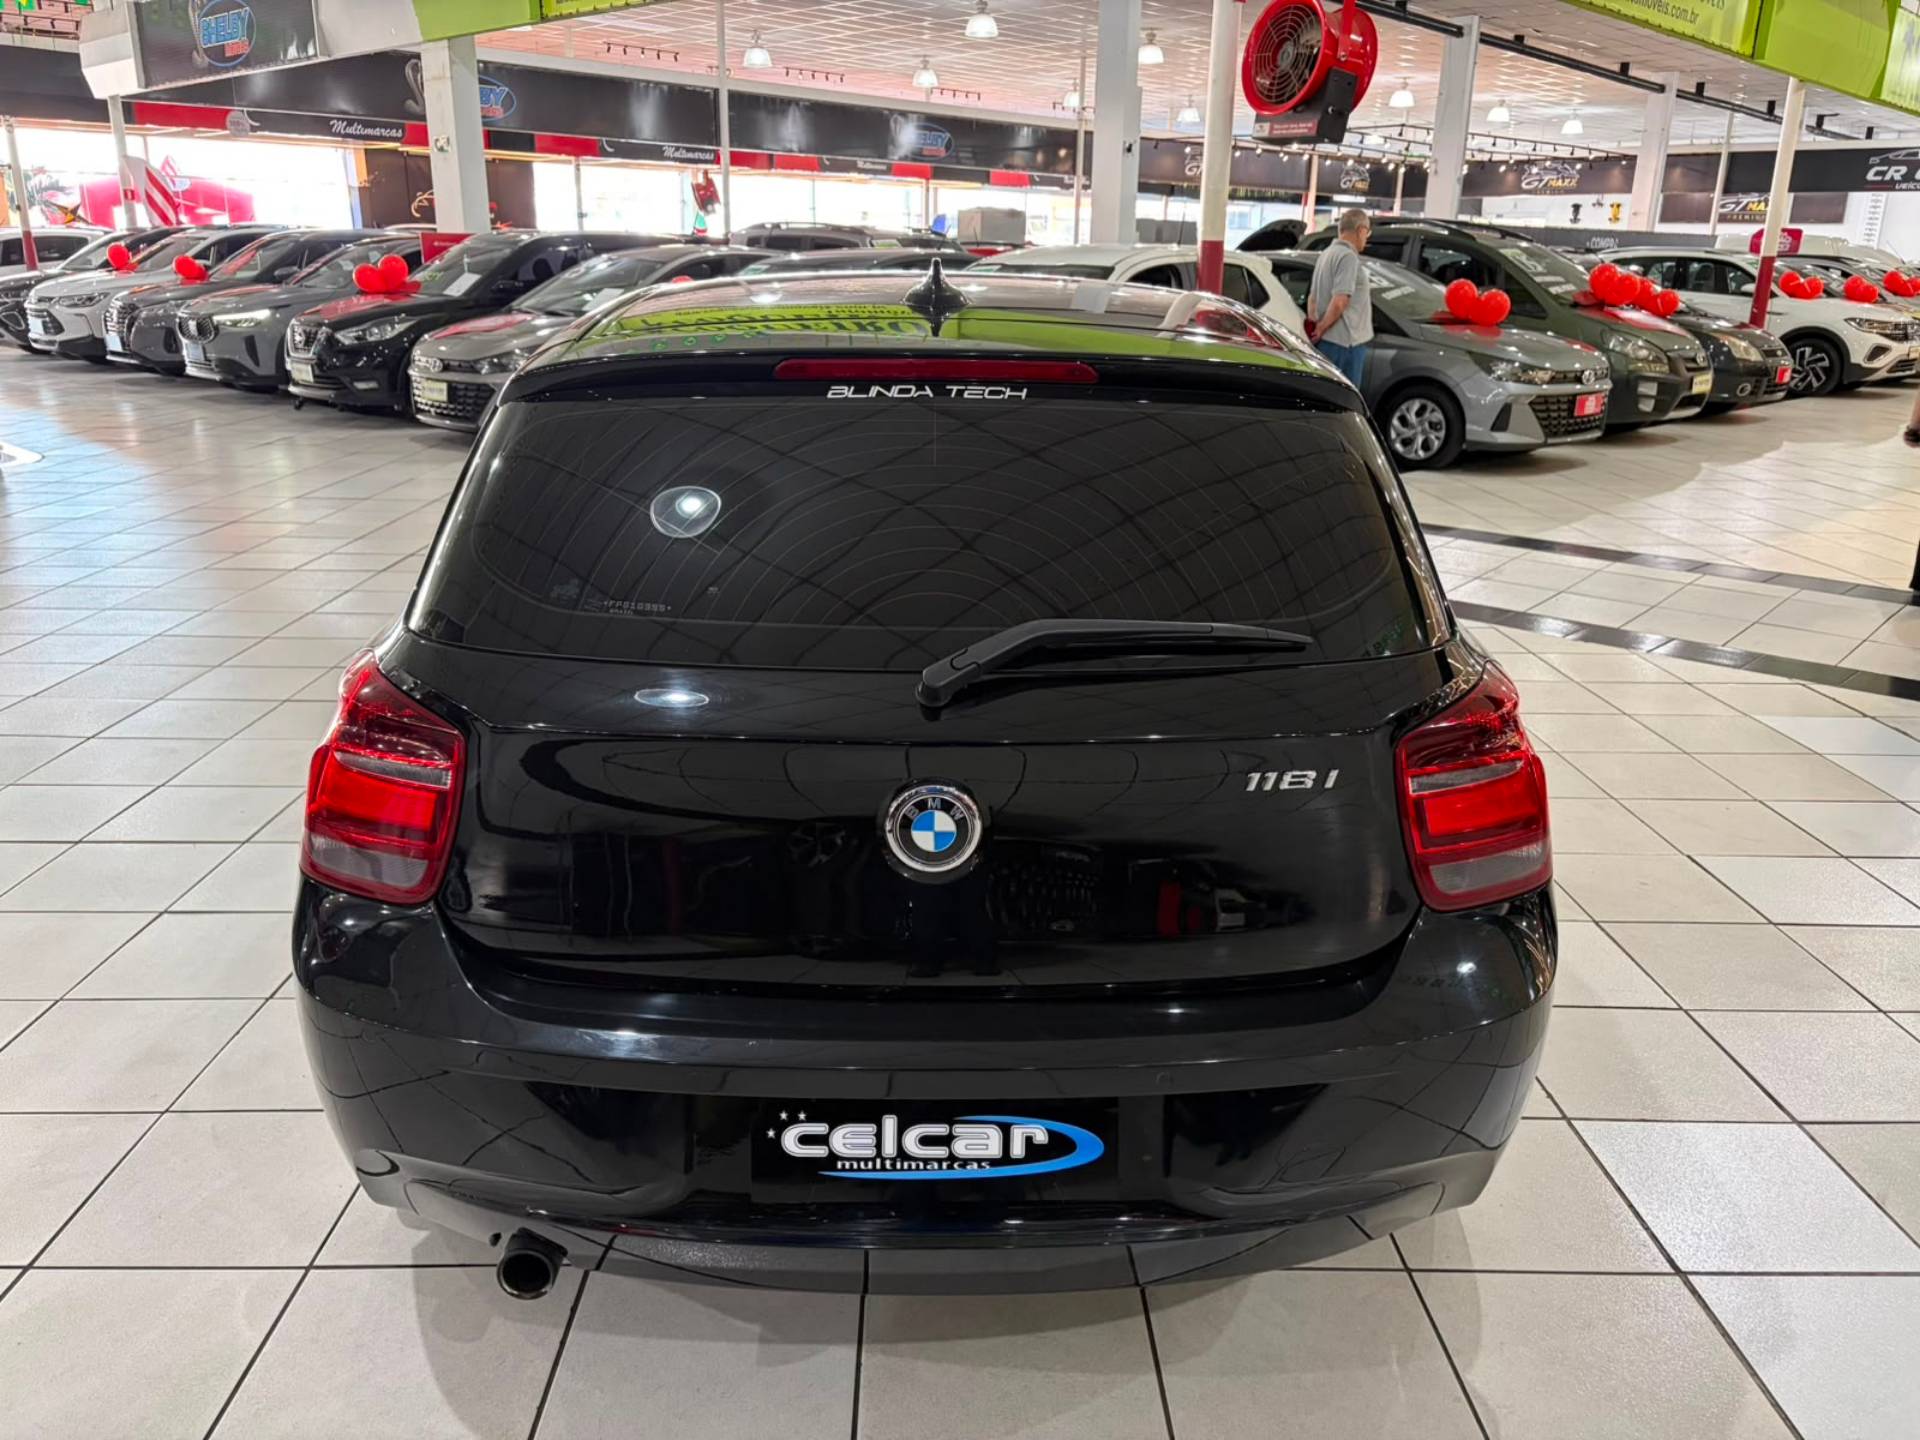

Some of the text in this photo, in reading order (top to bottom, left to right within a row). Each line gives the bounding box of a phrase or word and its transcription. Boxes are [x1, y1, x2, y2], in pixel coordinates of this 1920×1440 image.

[329, 120, 403, 137] Multimarcas
[827, 386, 1028, 400] BLINDA TECH
[904, 797, 964, 821] BMW
[781, 1114, 1049, 1159] celcar
[836, 1157, 991, 1171] multimarcas
